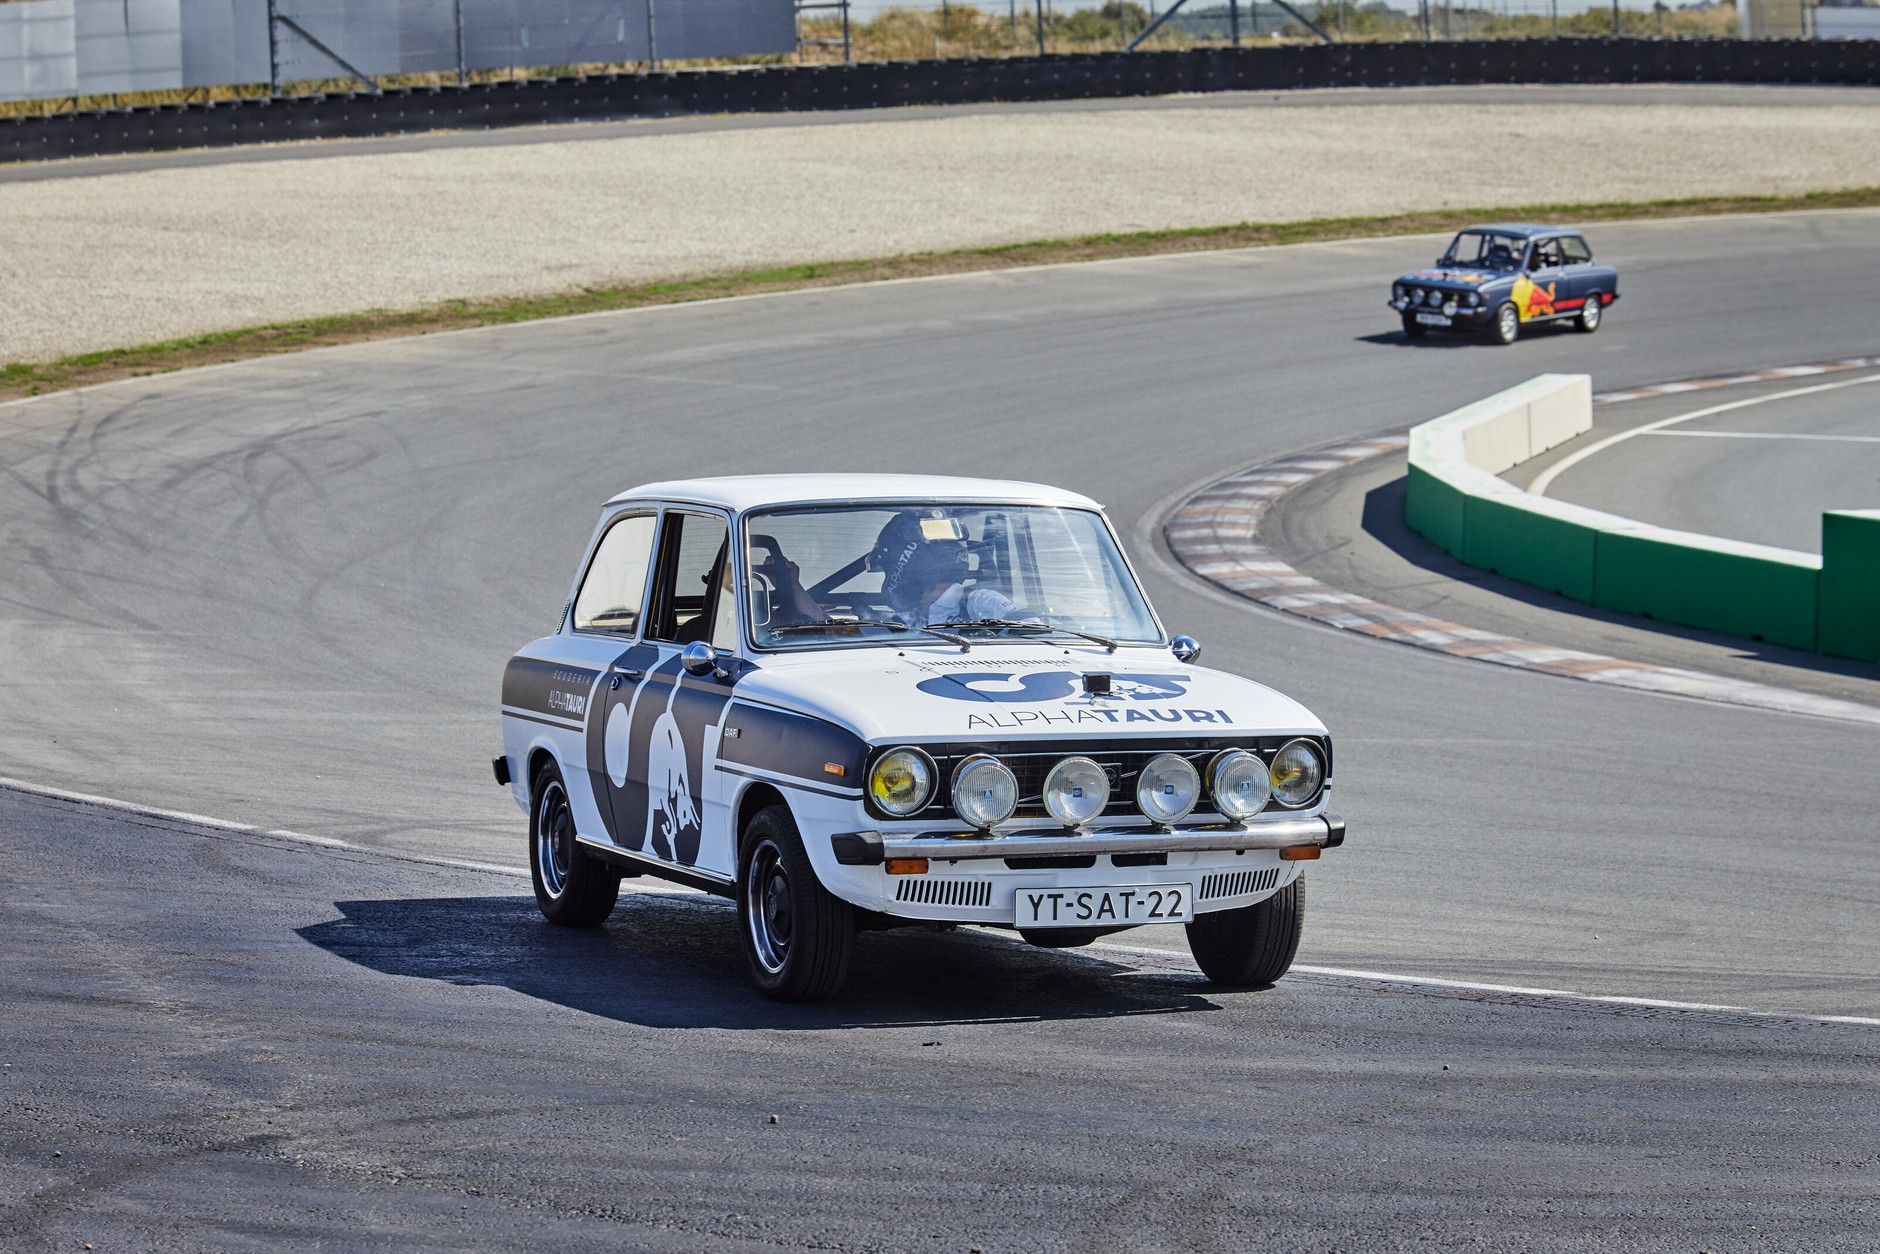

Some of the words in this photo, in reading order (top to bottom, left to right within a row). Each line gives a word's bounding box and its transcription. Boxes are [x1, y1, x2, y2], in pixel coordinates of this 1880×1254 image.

[888, 541, 918, 595] ALPHATAU
[548, 690, 586, 715] ALPHATAURI
[968, 709, 1234, 729] ALPHATAURI
[1028, 890, 1183, 921] YT-SAT-22
